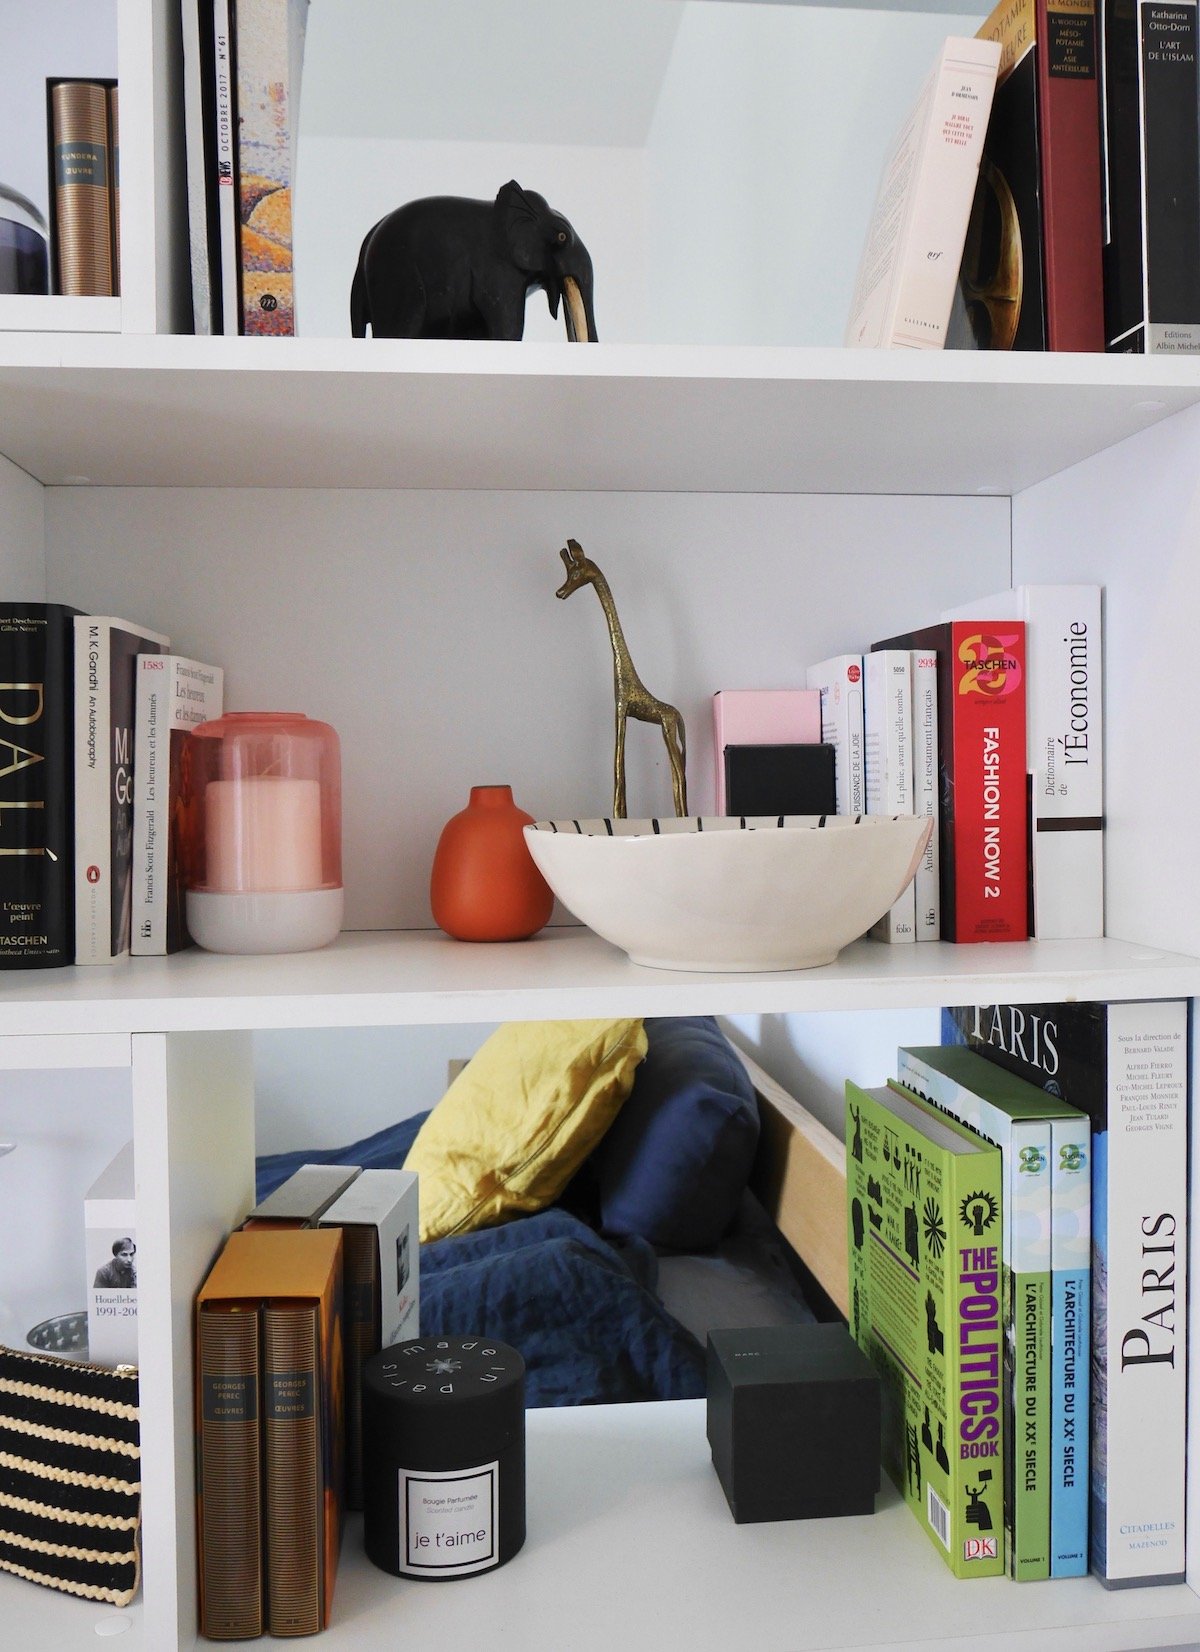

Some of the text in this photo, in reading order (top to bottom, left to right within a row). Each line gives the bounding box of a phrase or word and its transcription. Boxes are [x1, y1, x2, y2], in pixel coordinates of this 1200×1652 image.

[1151, 10, 1188, 20] Katharina
[1149, 22, 1191, 31] Otto-Dorn
[1055, 39, 1085, 47] POTAMIE
[1160, 41, 1181, 50] L'ART
[1148, 52, 1194, 61] DE L'ISLAM
[219, 74, 228, 98] 2017
[220, 104, 229, 151] OCTOBRE
[1156, 342, 1175, 350] Albin
[88, 626, 99, 639] M.
[88, 651, 99, 691] Gandhi
[143, 661, 164, 670] 1583
[964, 660, 1017, 670] TASCHEN
[1057, 621, 1089, 765] l'Économie
[895, 688, 904, 715] tombe
[922, 689, 933, 728] français
[87, 695, 97, 769] An Autobiography
[897, 746, 905, 767] avant
[925, 729, 933, 777] testament
[852, 733, 861, 812] PUISSANCE DE LA JOIE
[983, 727, 1001, 820] FASHION
[1045, 736, 1055, 796] Dictionnaire
[924, 779, 933, 792] Le
[1058, 783, 1068, 796] de
[145, 693, 157, 904] Francis Scott Fitzgerald Les heureux et les damnés
[897, 794, 905, 804] La
[983, 827, 1001, 881] NOW
[984, 886, 1001, 898] 2
[10, 911, 34, 923] peint
[896, 924, 912, 933] folio
[0, 935, 48, 947] TASCHEN
[971, 1004, 1059, 1076] PARIS
[1143, 1033, 1172, 1041] direction
[1173, 1032, 1182, 1040] de
[959, 1247, 999, 1272] THE
[1026, 1283, 1036, 1392] L'ARCHITECTURE
[1064, 1280, 1076, 1389] L'ARCHITECTURE
[403, 1341, 497, 1357] made
[959, 1271, 1000, 1442] POLITICS
[212, 1382, 246, 1390] GEORGES
[273, 1379, 307, 1388] GEORGES
[217, 1392, 240, 1400] PEREC
[278, 1390, 300, 1398] PEREC
[214, 1407, 244, 1415] ŒUVRES
[274, 1404, 305, 1413] ŒUVRES
[1026, 1397, 1036, 1416] DU
[1064, 1393, 1075, 1413] DU
[960, 1441, 1000, 1460] BOOK
[1025, 1450, 1036, 1491] SIECLE
[1063, 1446, 1075, 1488] SIECLE
[422, 1497, 446, 1506] Bougie
[1120, 1522, 1175, 1535] CITADELLES
[414, 1529, 486, 1550] je t'aime
[966, 1538, 994, 1557] DK
[1129, 1540, 1168, 1550] MAZENOD
